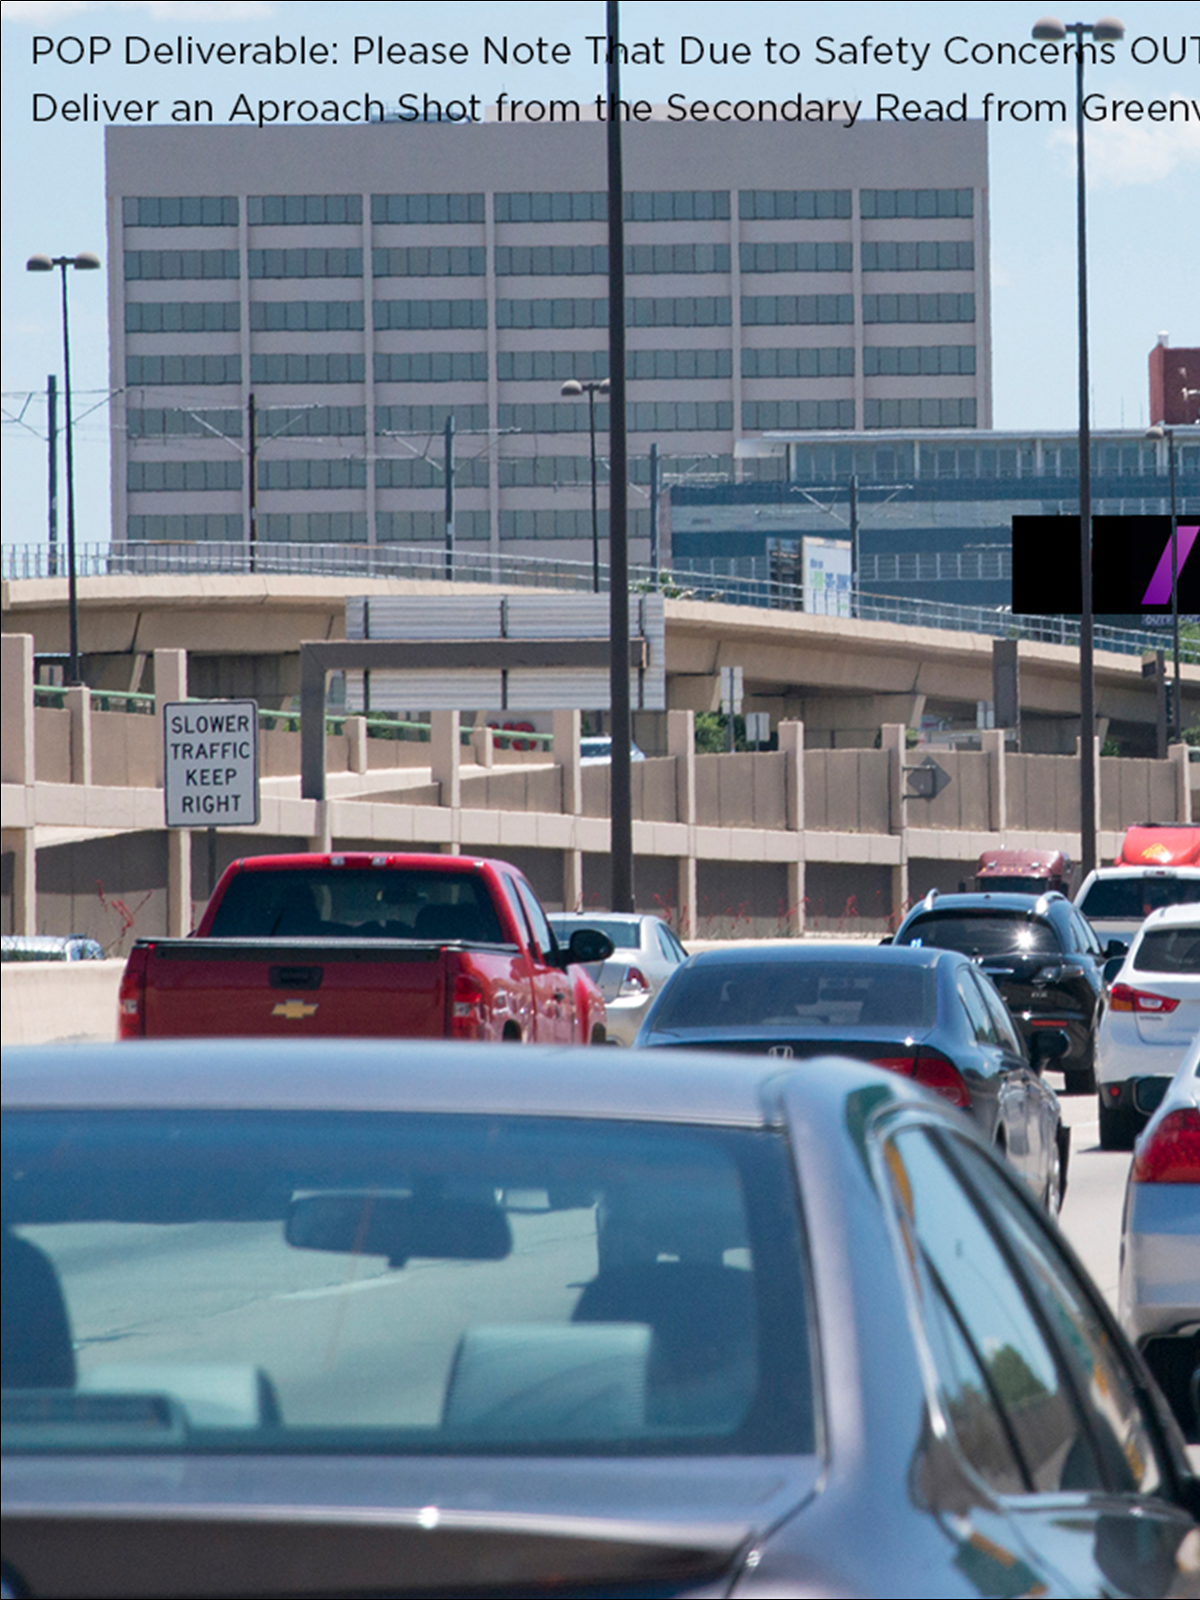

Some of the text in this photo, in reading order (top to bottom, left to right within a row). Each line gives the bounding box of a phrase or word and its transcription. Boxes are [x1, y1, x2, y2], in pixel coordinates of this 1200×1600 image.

[171, 714, 250, 734] SLOWER
[170, 741, 251, 760] TRAFFIC
[186, 768, 238, 787] KEEP
[182, 794, 242, 814] RIGHT
